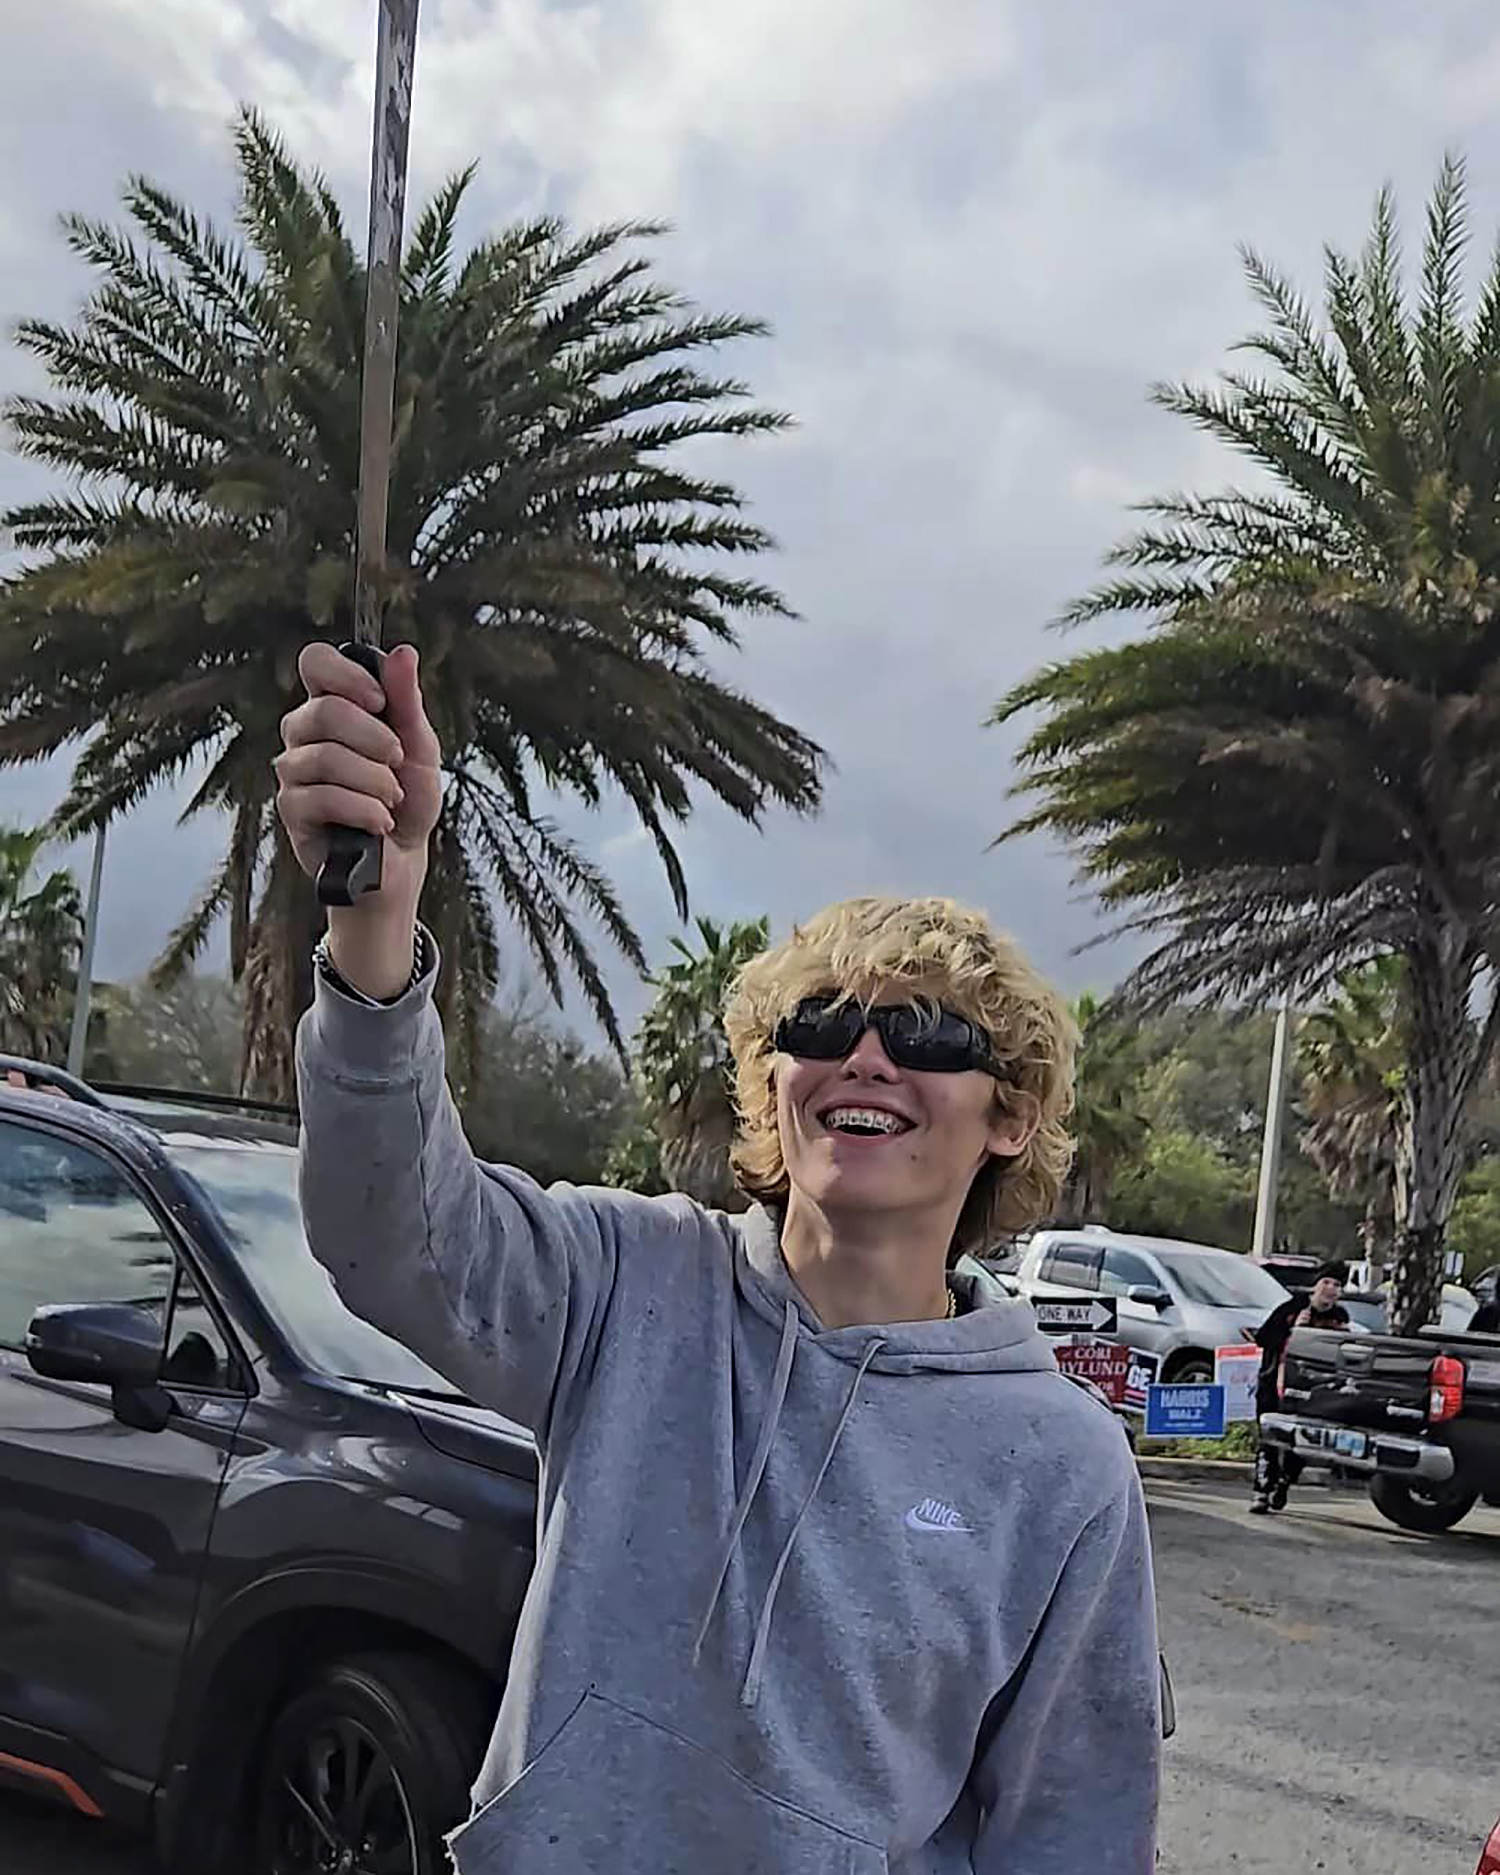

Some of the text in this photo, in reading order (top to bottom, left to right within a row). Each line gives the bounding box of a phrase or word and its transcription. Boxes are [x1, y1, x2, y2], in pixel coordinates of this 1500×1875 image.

[1038, 1306, 1091, 1321] ONE WAY
[918, 1498, 961, 1528] NIKE
